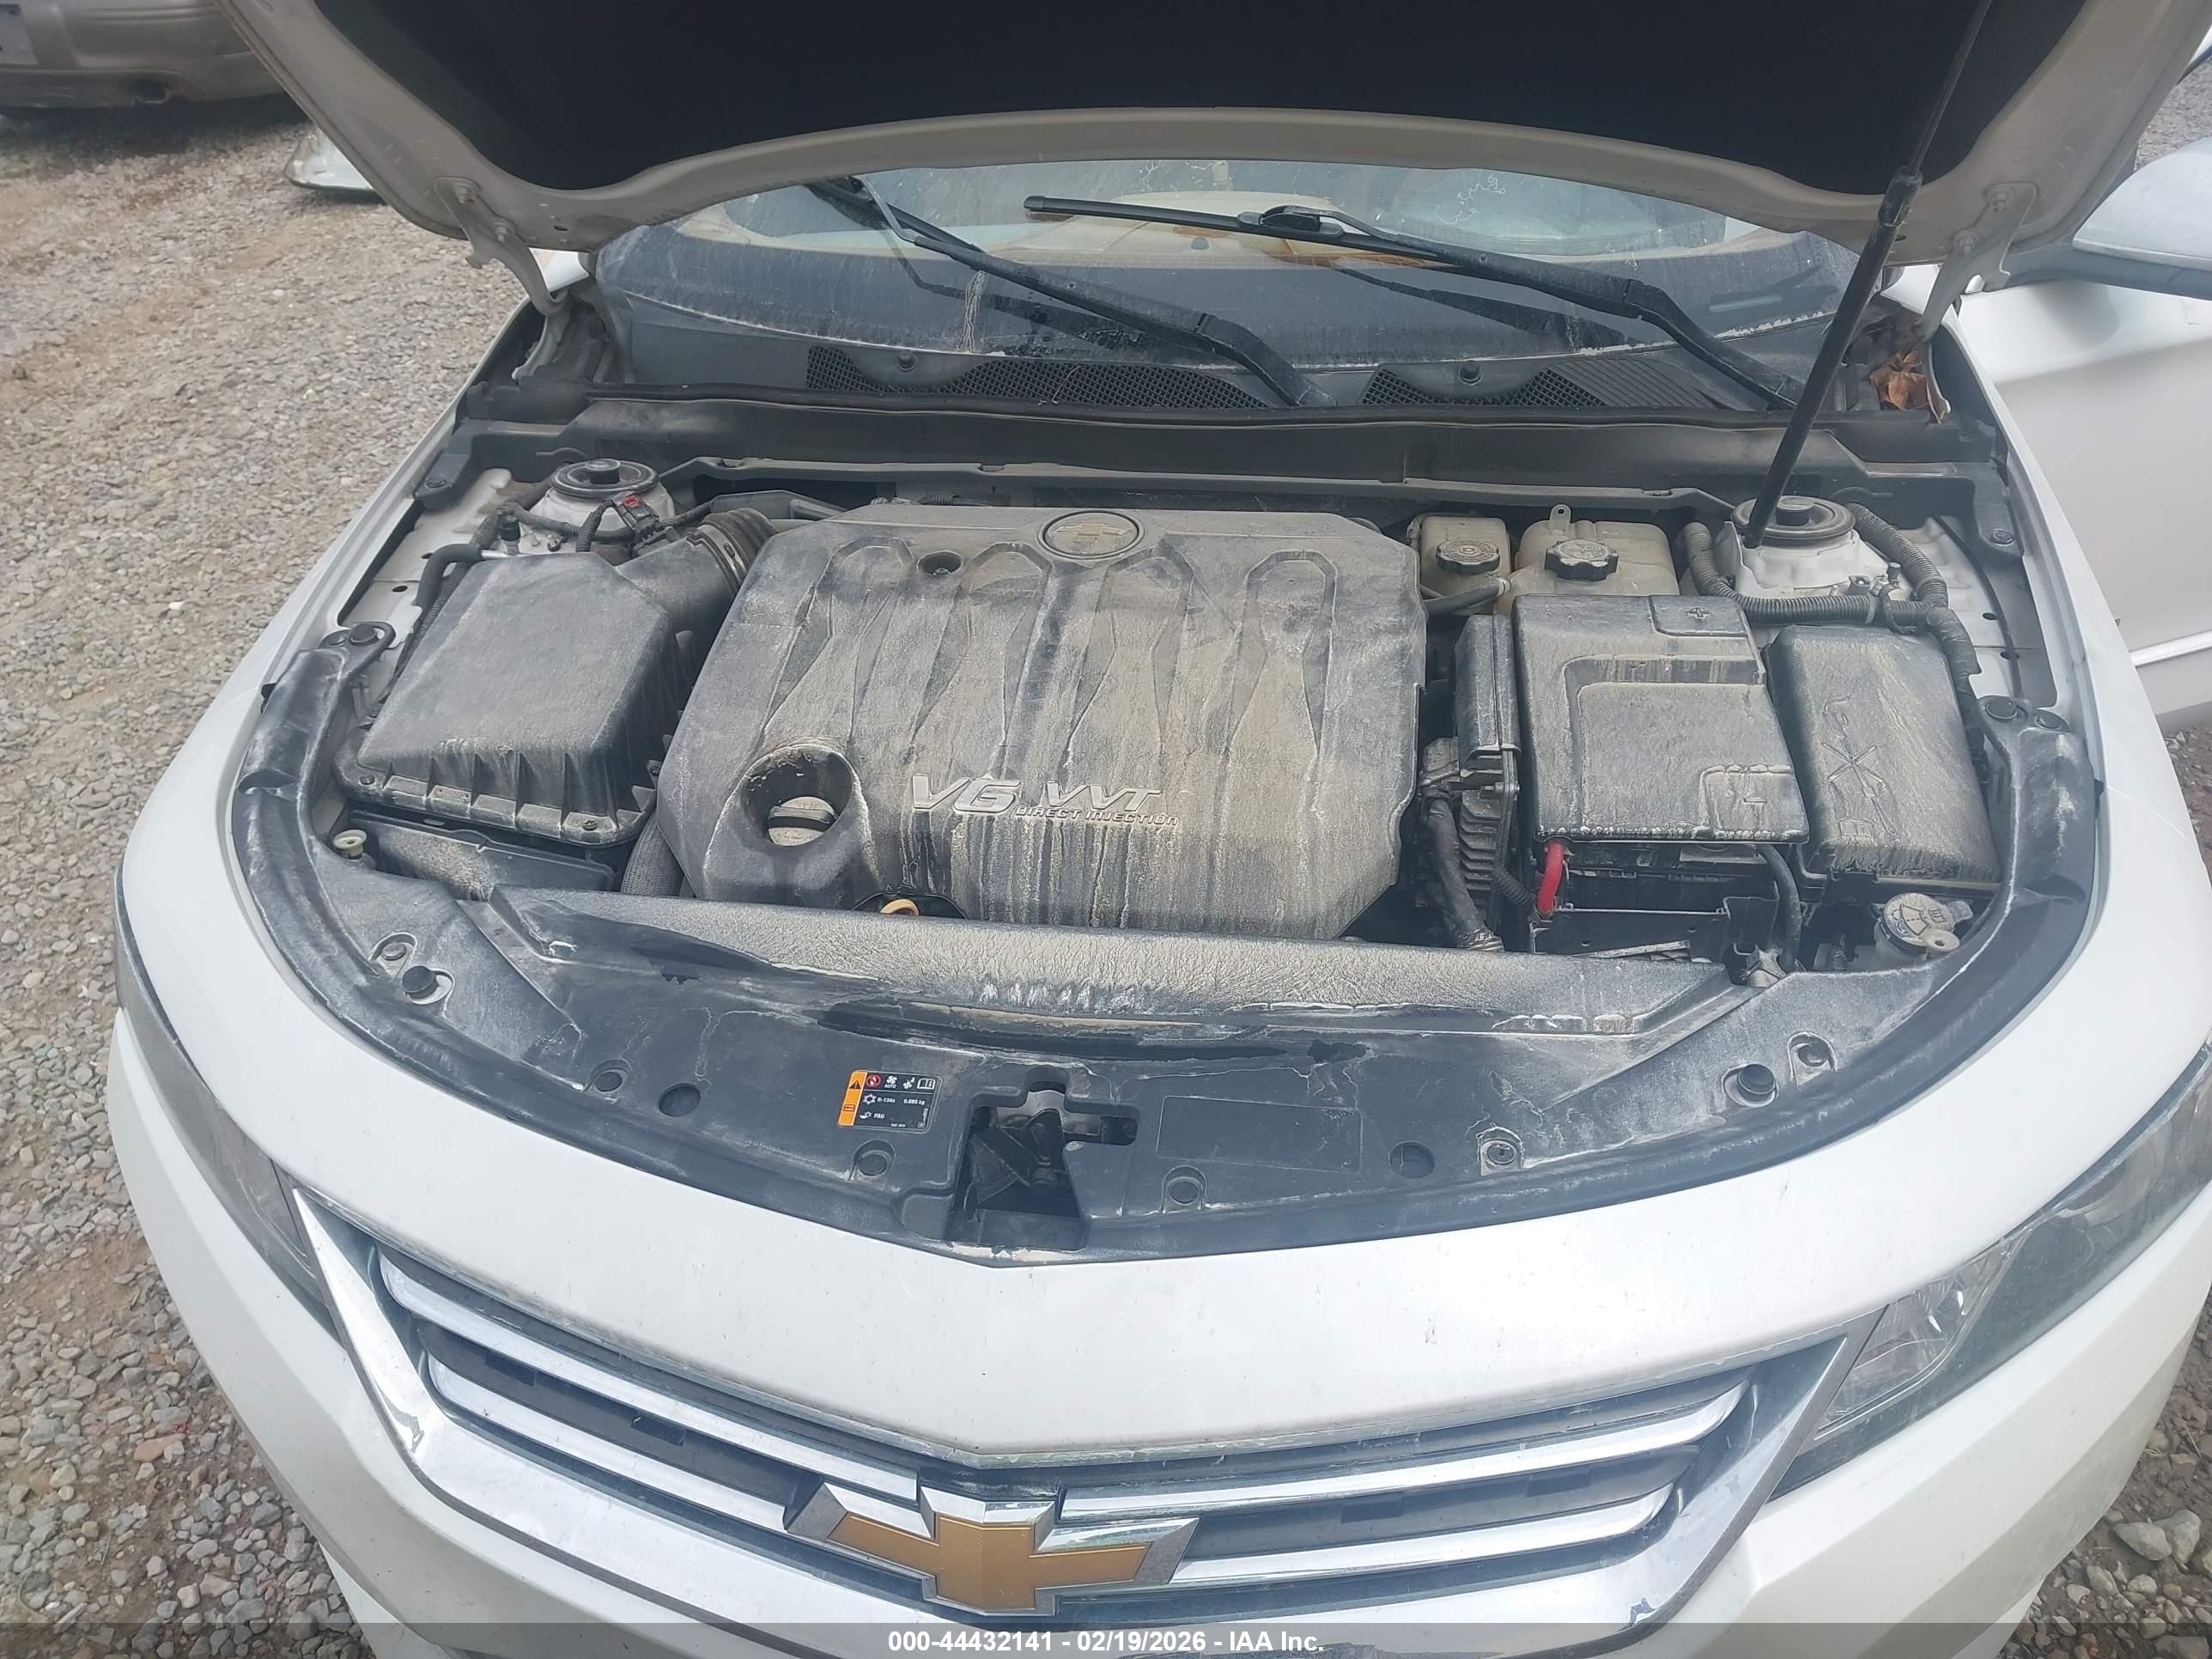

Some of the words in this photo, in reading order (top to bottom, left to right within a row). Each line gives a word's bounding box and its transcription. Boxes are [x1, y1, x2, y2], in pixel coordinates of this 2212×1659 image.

[912, 775, 1022, 813] V6
[1045, 781, 1163, 812] VVT
[1015, 805, 1082, 820] DIRECT
